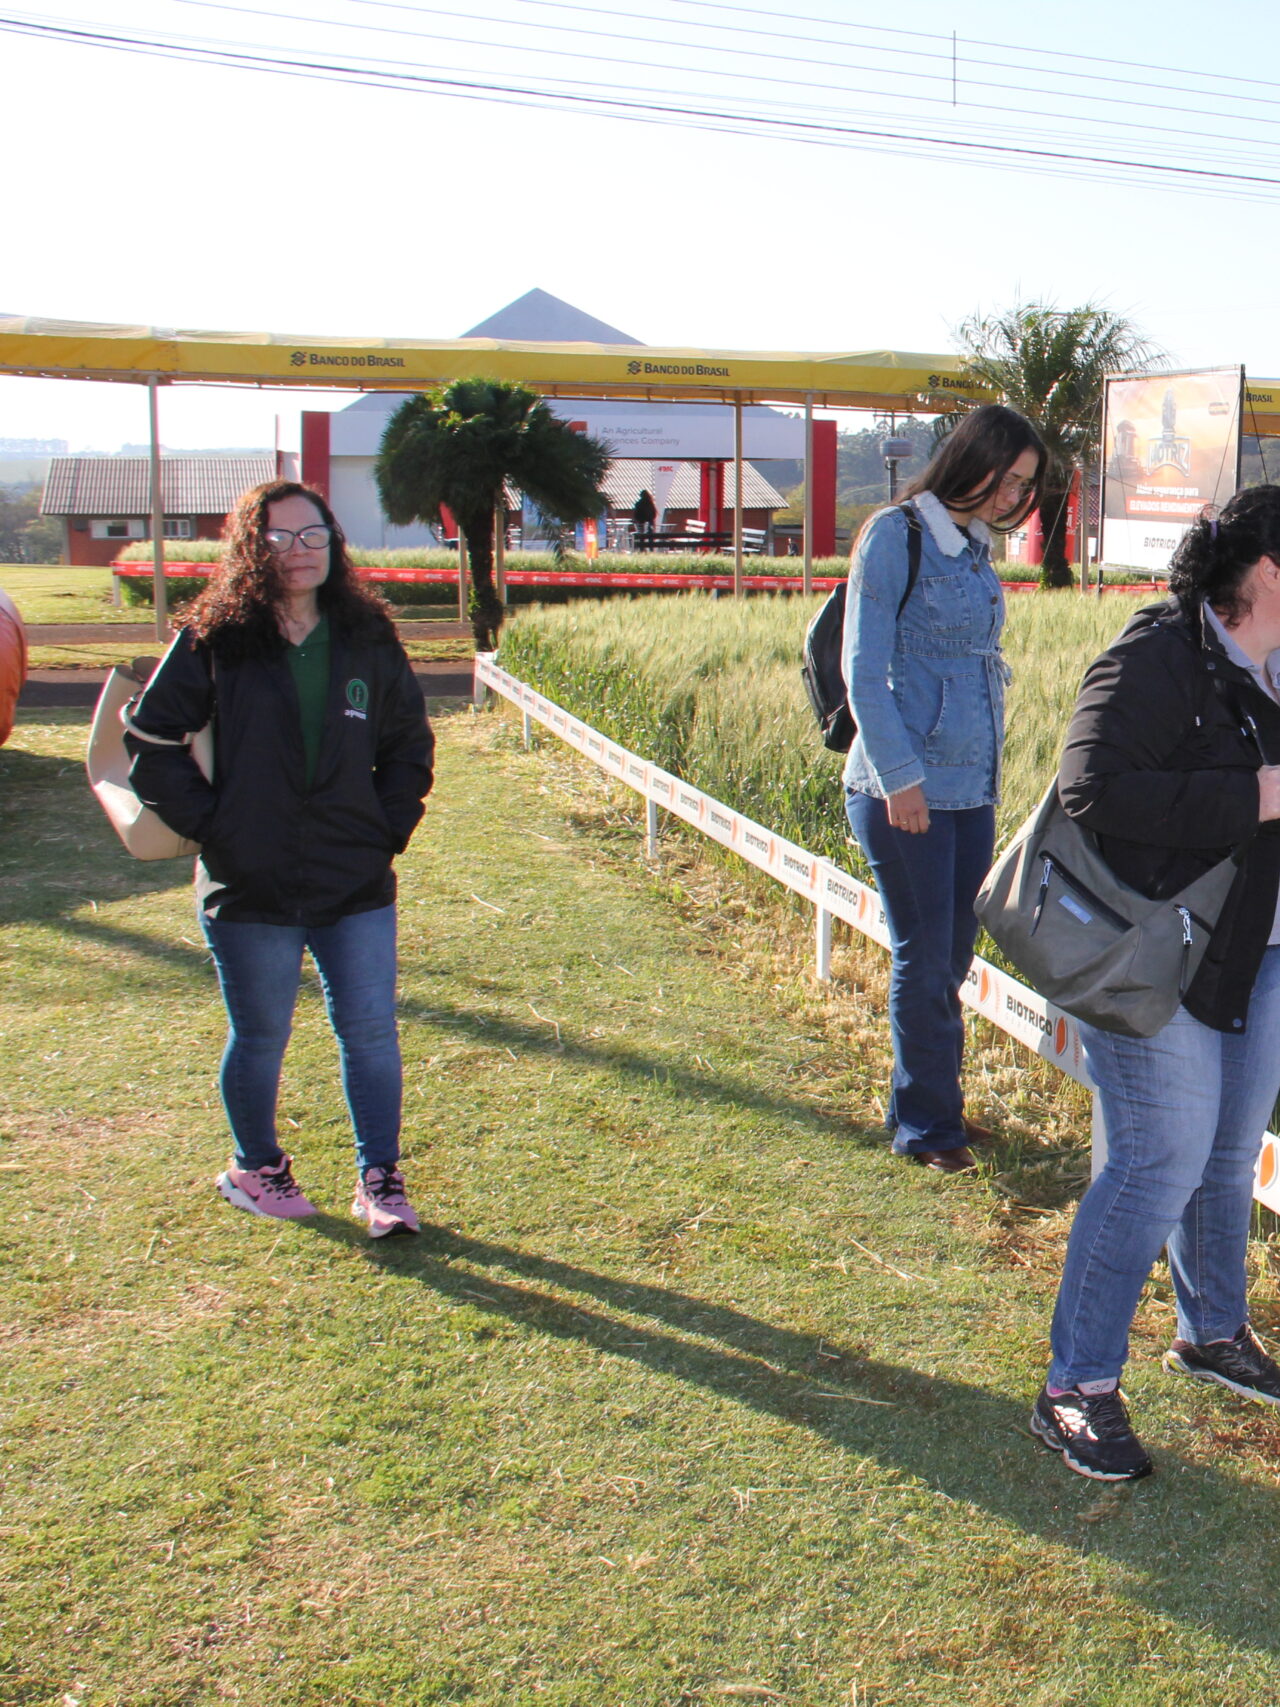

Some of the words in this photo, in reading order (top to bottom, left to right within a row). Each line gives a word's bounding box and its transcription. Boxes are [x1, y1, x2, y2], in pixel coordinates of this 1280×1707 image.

[310, 353, 349, 366] BANCO
[351, 356, 366, 366] DO
[367, 355, 406, 367] BRASIL
[644, 362, 680, 374] BANCO
[681, 365, 695, 375] DO
[696, 364, 730, 377] BRASIL
[1246, 392, 1274, 403] BRASIL
[616, 427, 663, 436] Agricultural
[642, 436, 680, 446] Company
[783, 854, 809, 878] BIOTRIGO
[827, 878, 858, 906] BIOTRIGO
[1006, 994, 1053, 1037] BIOTRIGO
